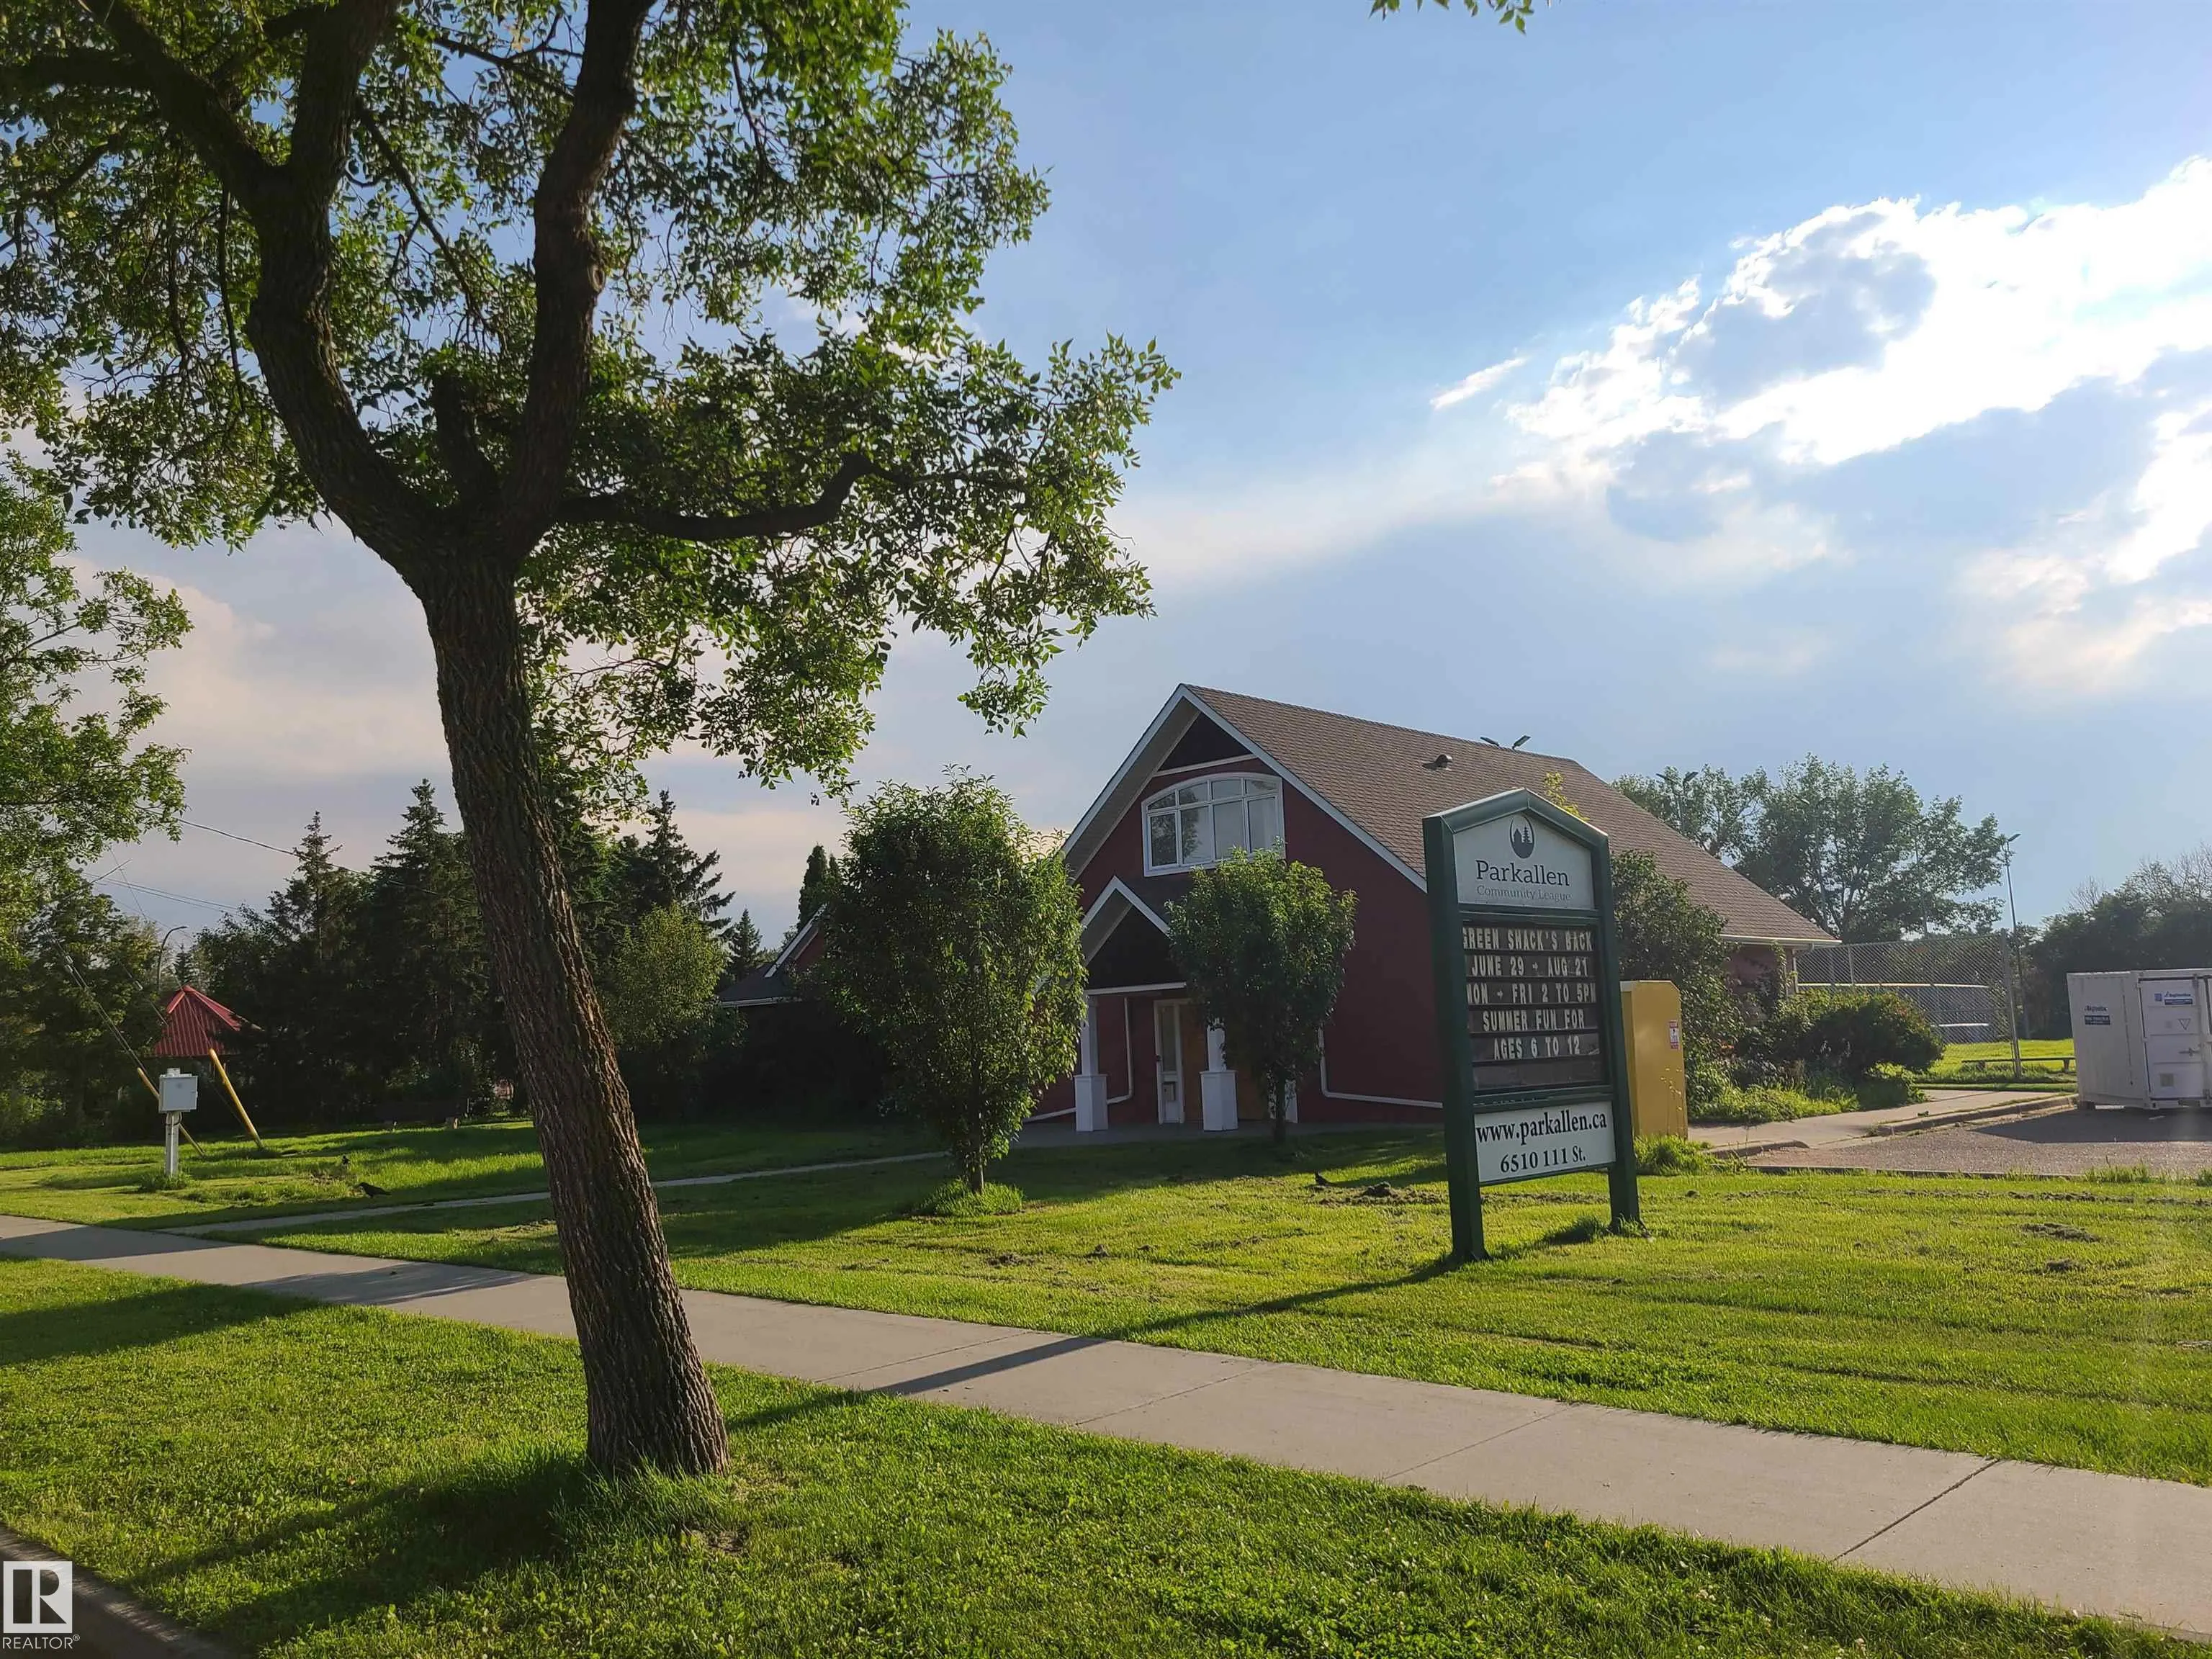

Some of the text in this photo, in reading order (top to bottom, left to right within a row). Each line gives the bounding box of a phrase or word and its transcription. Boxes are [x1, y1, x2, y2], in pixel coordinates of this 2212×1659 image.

[1475, 860, 1570, 886] Parkallen
[1477, 885, 1570, 902] Community League
[1462, 927, 1593, 951] GREEN SHACK'S BACK
[1472, 956, 1588, 977] JUNE 29 AUG 21
[1467, 983, 1596, 1004] MON FRI 2 TO 5PM
[1483, 1009, 1585, 1031] SUMMER FUN FOR
[1494, 1035, 1580, 1060] AGES 6 TO 12
[1476, 1110, 1607, 1146] www.parkallen.ca
[1501, 1146, 1586, 1173] 6510 111 St.
